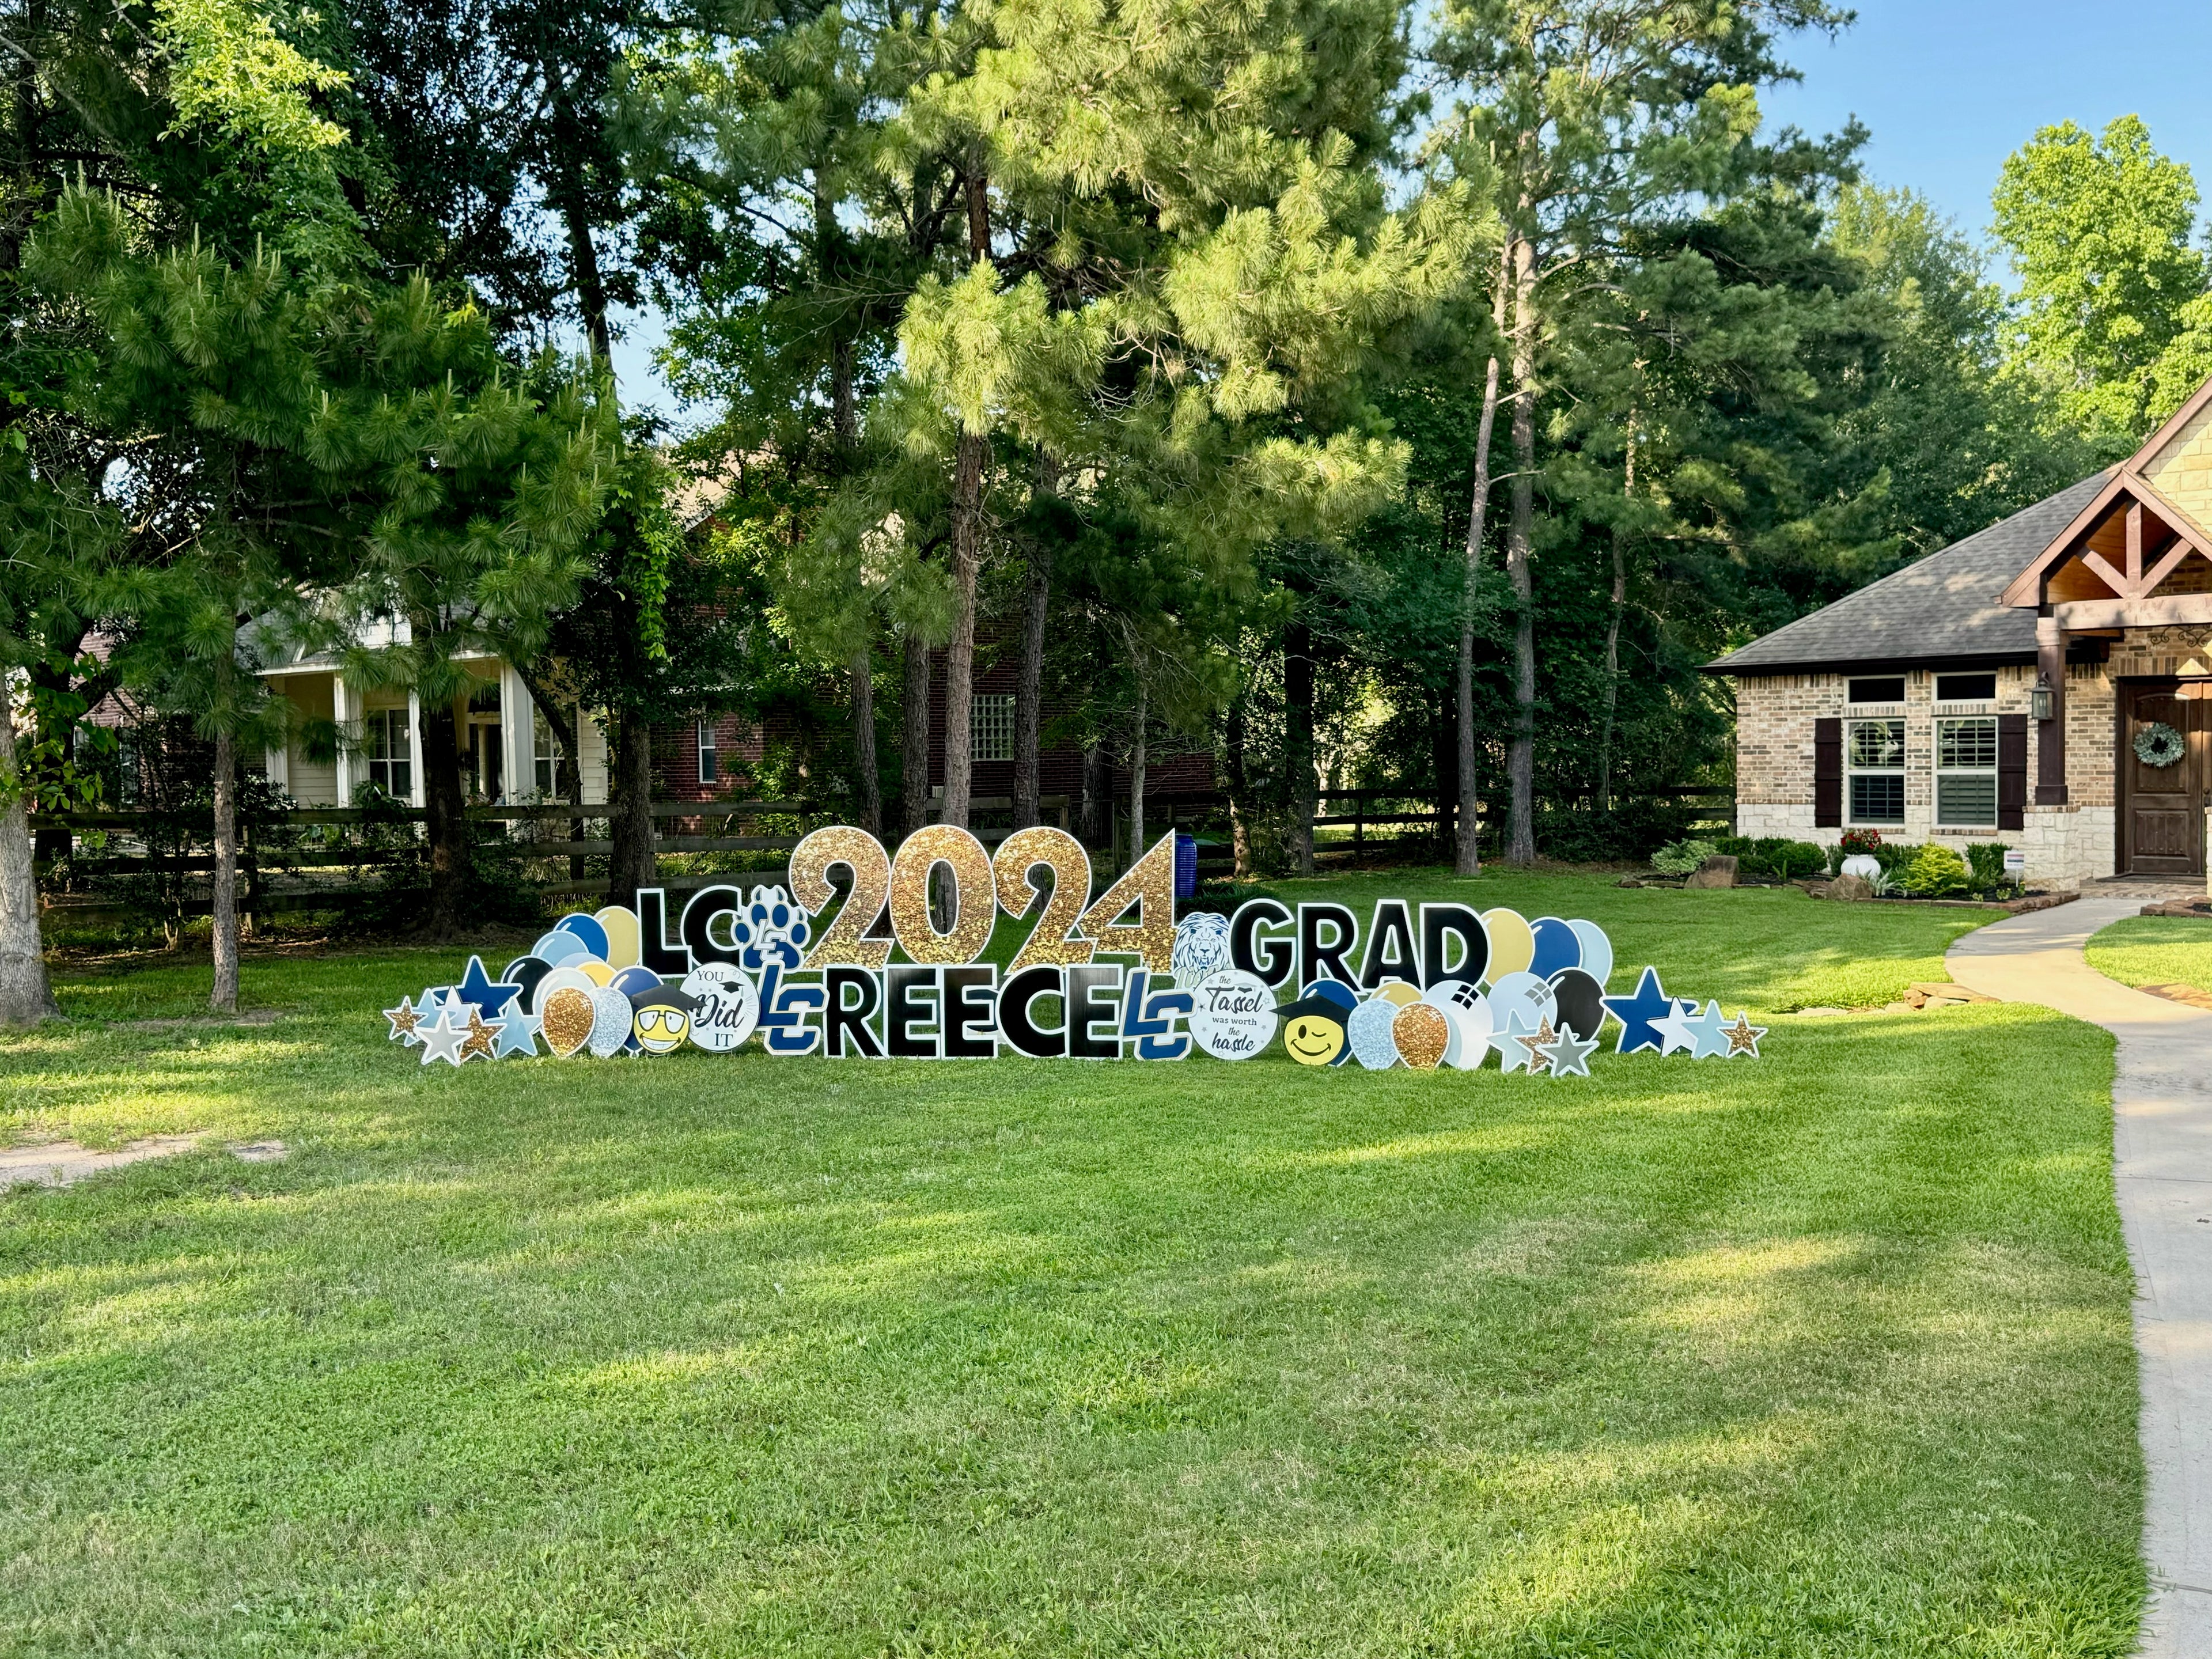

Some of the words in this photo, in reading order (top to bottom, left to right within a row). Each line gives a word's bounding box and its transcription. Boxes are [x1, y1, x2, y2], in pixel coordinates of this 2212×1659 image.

[637, 885, 744, 978] LC
[789, 825, 1176, 976] 2024
[1229, 898, 1493, 995] GRAD
[696, 970, 724, 982] YOU
[1219, 975, 1232, 984] the
[689, 994, 745, 1028] Did
[756, 960, 830, 1055] LC
[824, 964, 1124, 1059] REECE
[1205, 986, 1264, 1014] Tassel
[1119, 967, 1198, 1061] LC
[1231, 1018, 1257, 1026] worth
[714, 1033, 734, 1047] IT
[1211, 1032, 1256, 1052] hassle
[1228, 1027, 1241, 1036] the
